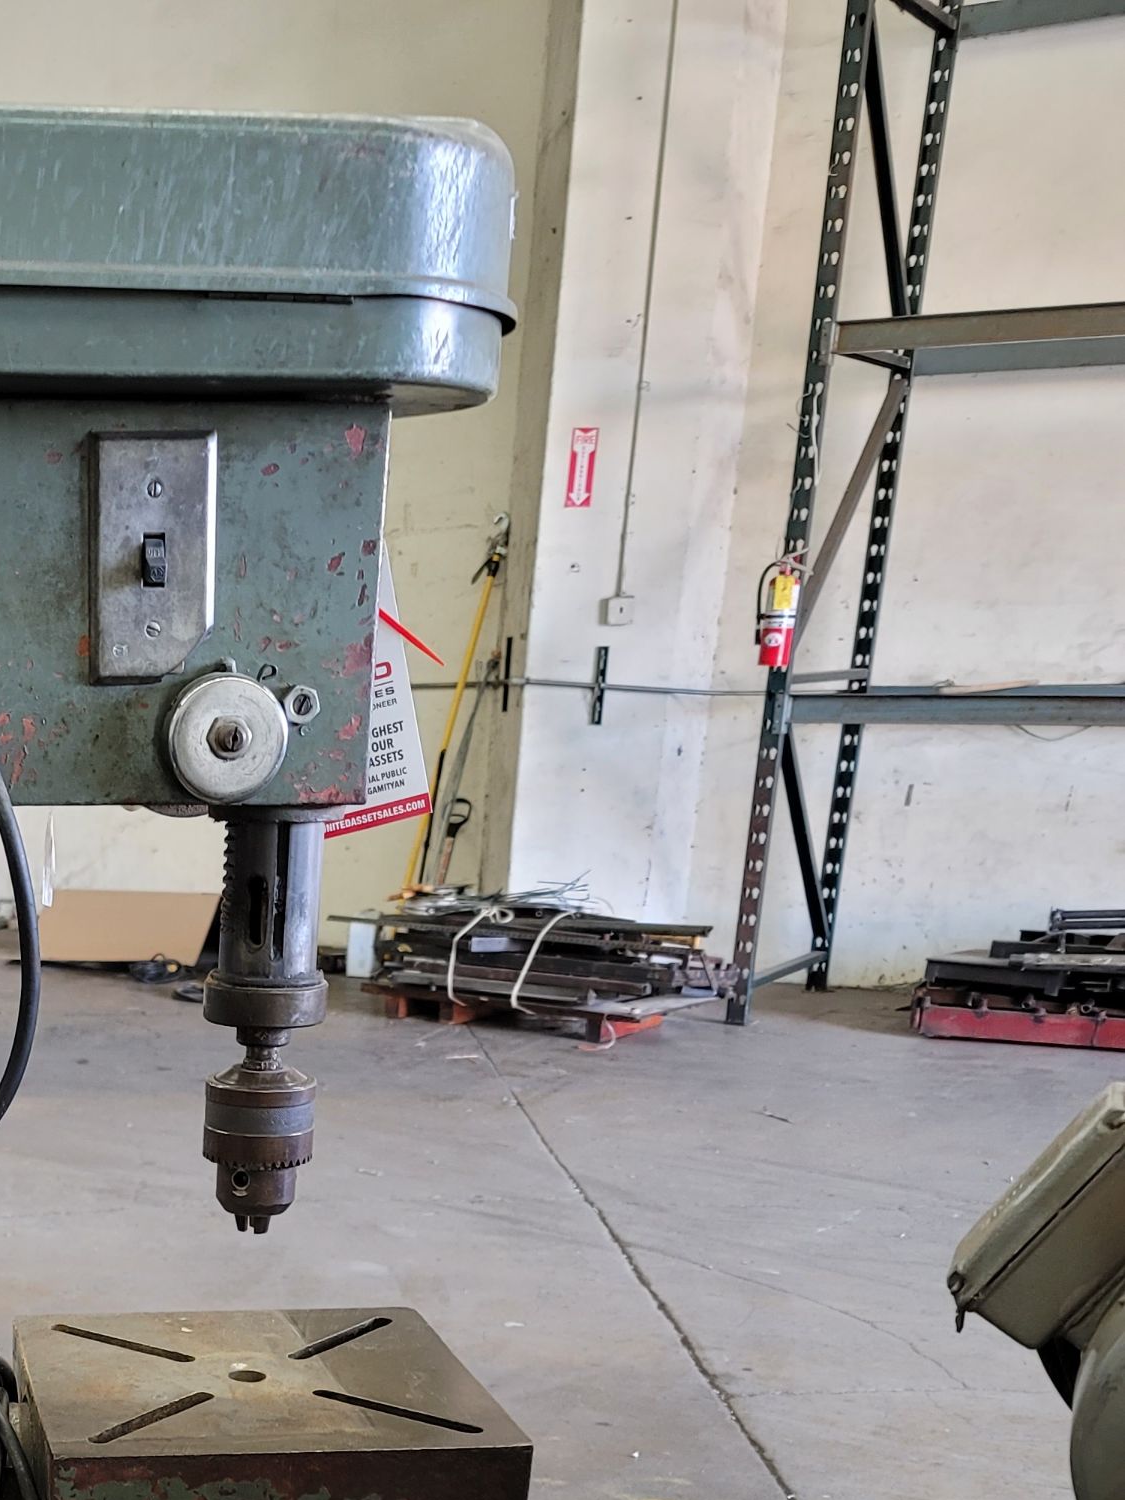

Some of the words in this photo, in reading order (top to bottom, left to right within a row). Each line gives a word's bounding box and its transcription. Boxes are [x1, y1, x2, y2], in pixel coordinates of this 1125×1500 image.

[375, 687, 395, 698] ES
[371, 720, 404, 738] GHEST
[371, 738, 394, 753] OUR
[369, 749, 404, 768] ASSETS
[381, 766, 407, 781] PUBLIC
[367, 779, 405, 795] GAMITYAN
